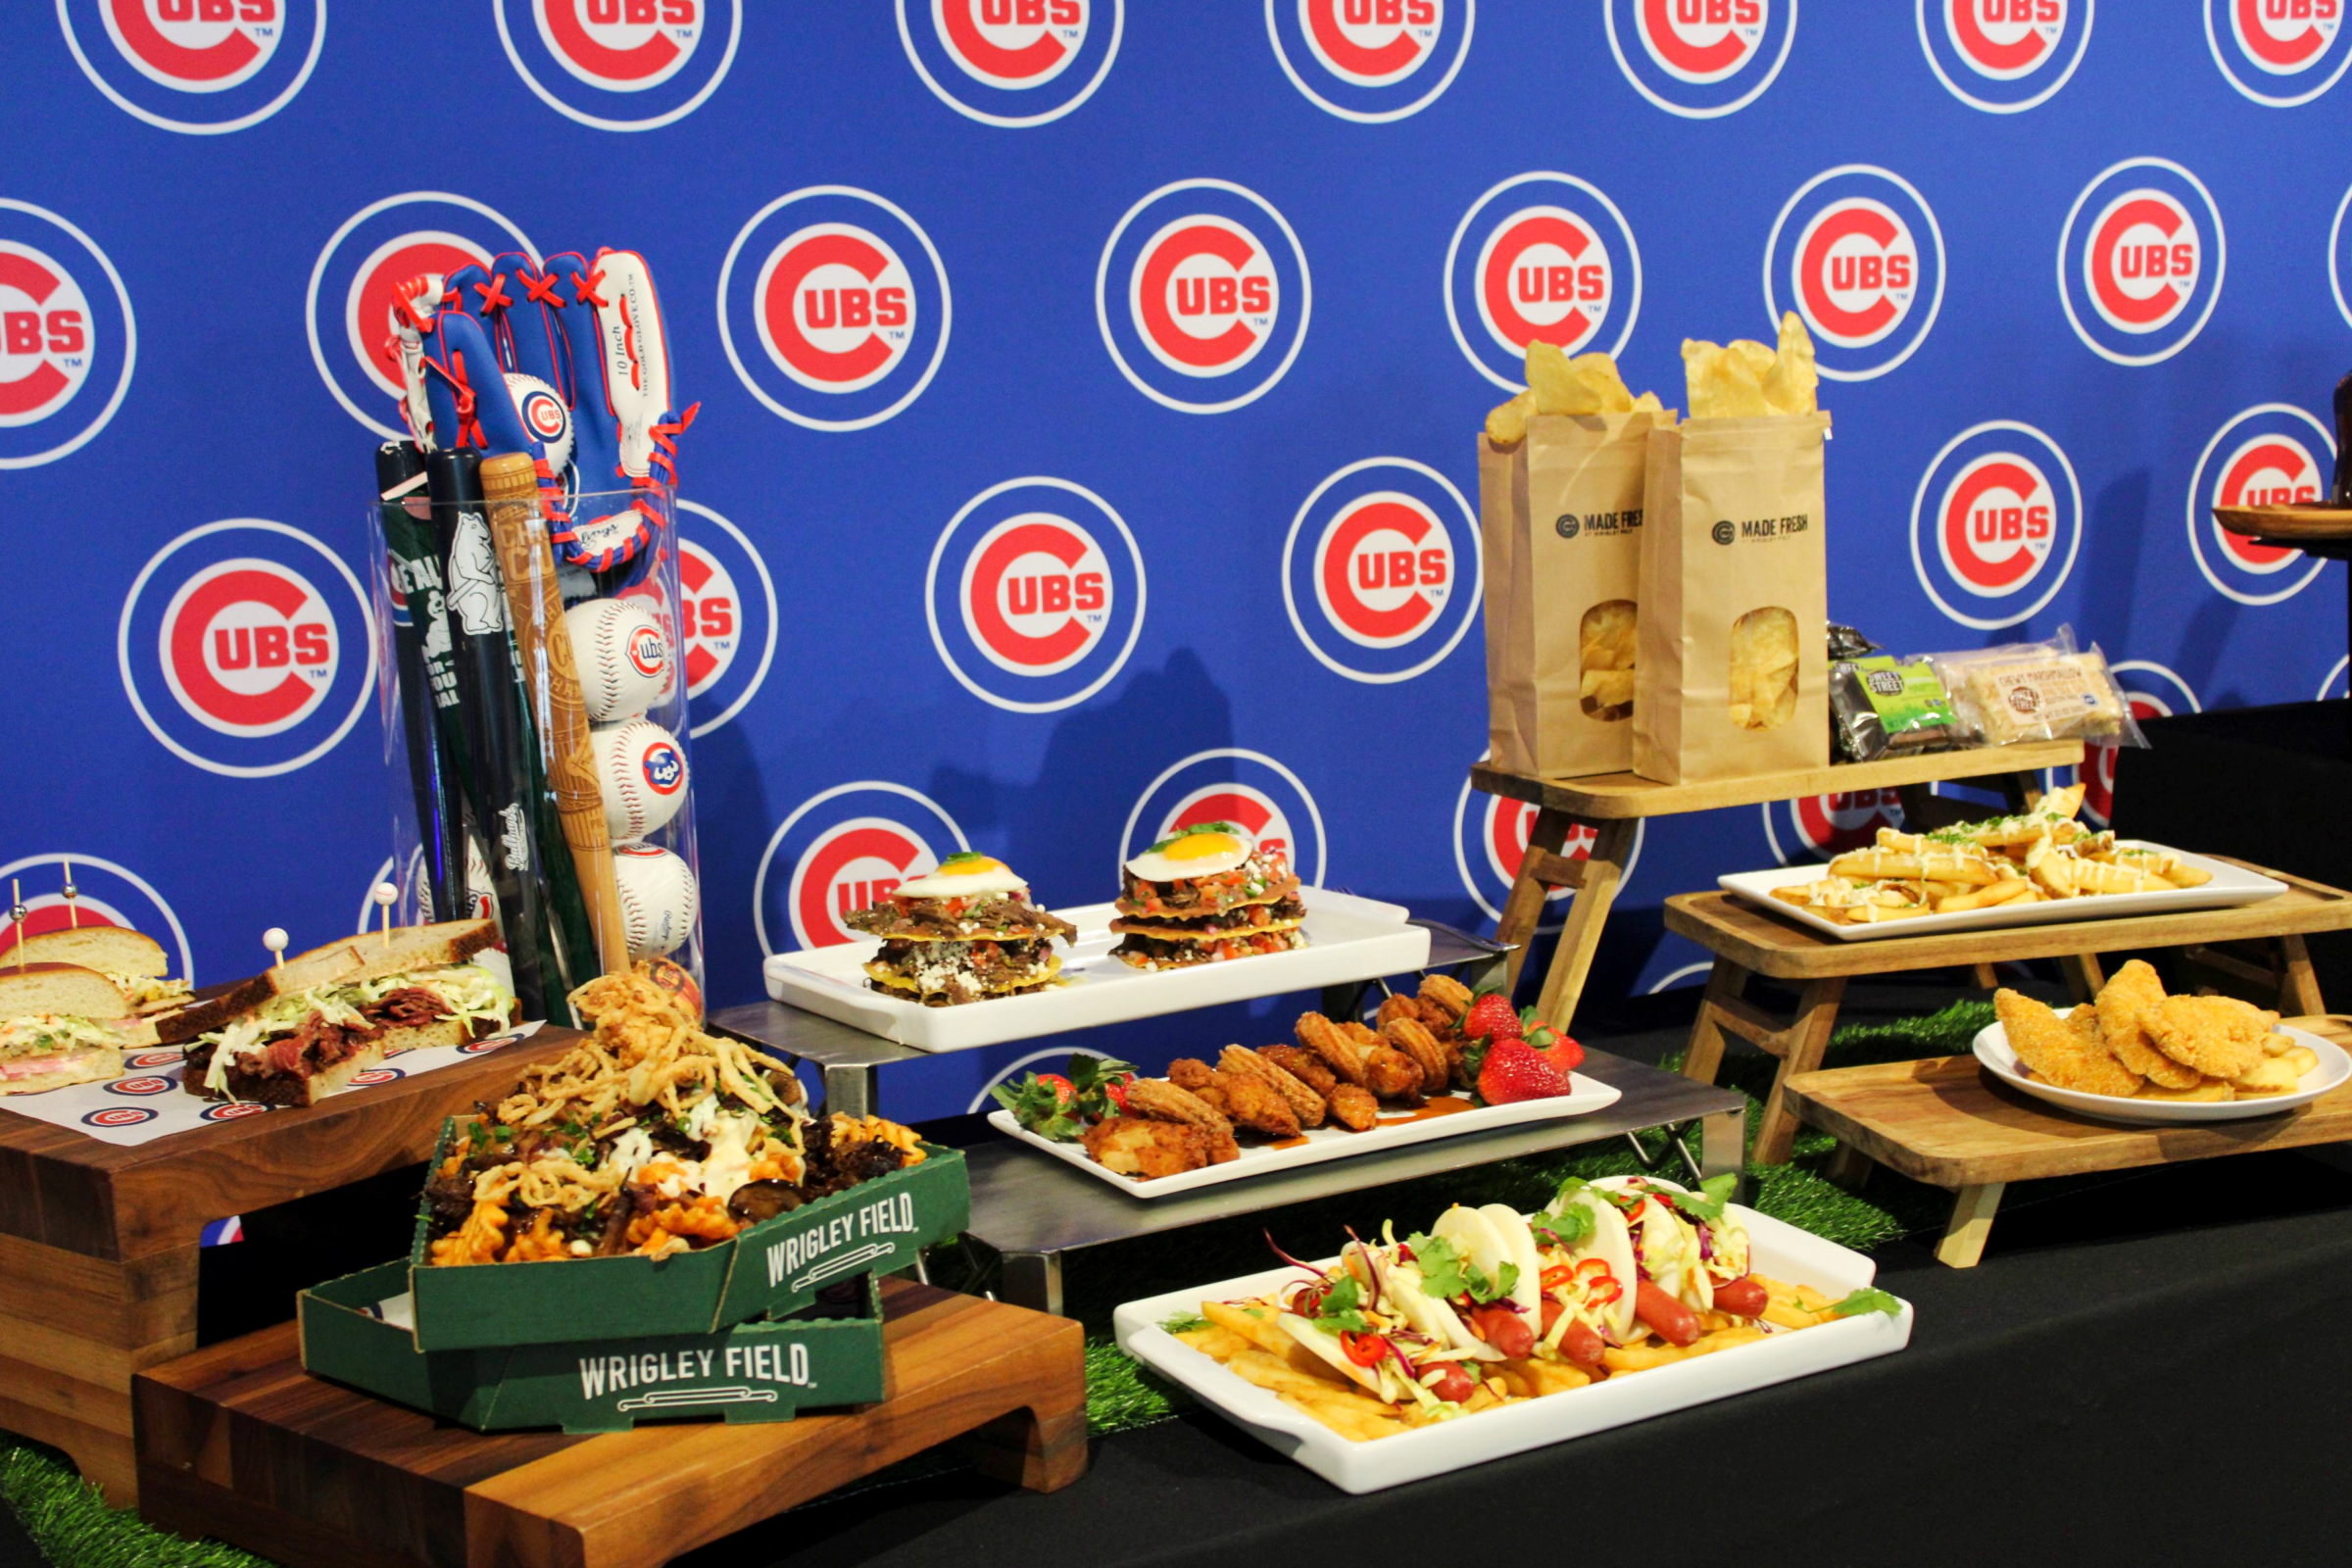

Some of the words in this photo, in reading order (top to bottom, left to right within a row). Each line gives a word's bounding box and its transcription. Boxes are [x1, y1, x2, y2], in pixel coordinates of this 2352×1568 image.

[765, 234, 907, 383] CUBS
[1140, 225, 1271, 368] CUBS
[1485, 217, 1604, 349] CUBS
[1801, 208, 1911, 338] CUBS
[2092, 199, 2193, 323] CUBS
[612, 325, 626, 357] Inch
[617, 361, 629, 376] 10
[1323, 502, 1447, 639] CUBS
[1584, 513, 1619, 530] MADE
[1741, 518, 1777, 538] MADE
[1780, 514, 1808, 535] FRESH
[1945, 463, 2049, 588] CUBS
[172, 570, 330, 727] CUBS
[970, 523, 1105, 666] CUBS
[766, 1212, 854, 1288] WRIGLEY
[859, 1192, 913, 1237] FIELD
[579, 1348, 714, 1400] WRIGLEY
[725, 1343, 809, 1386] FIELD
